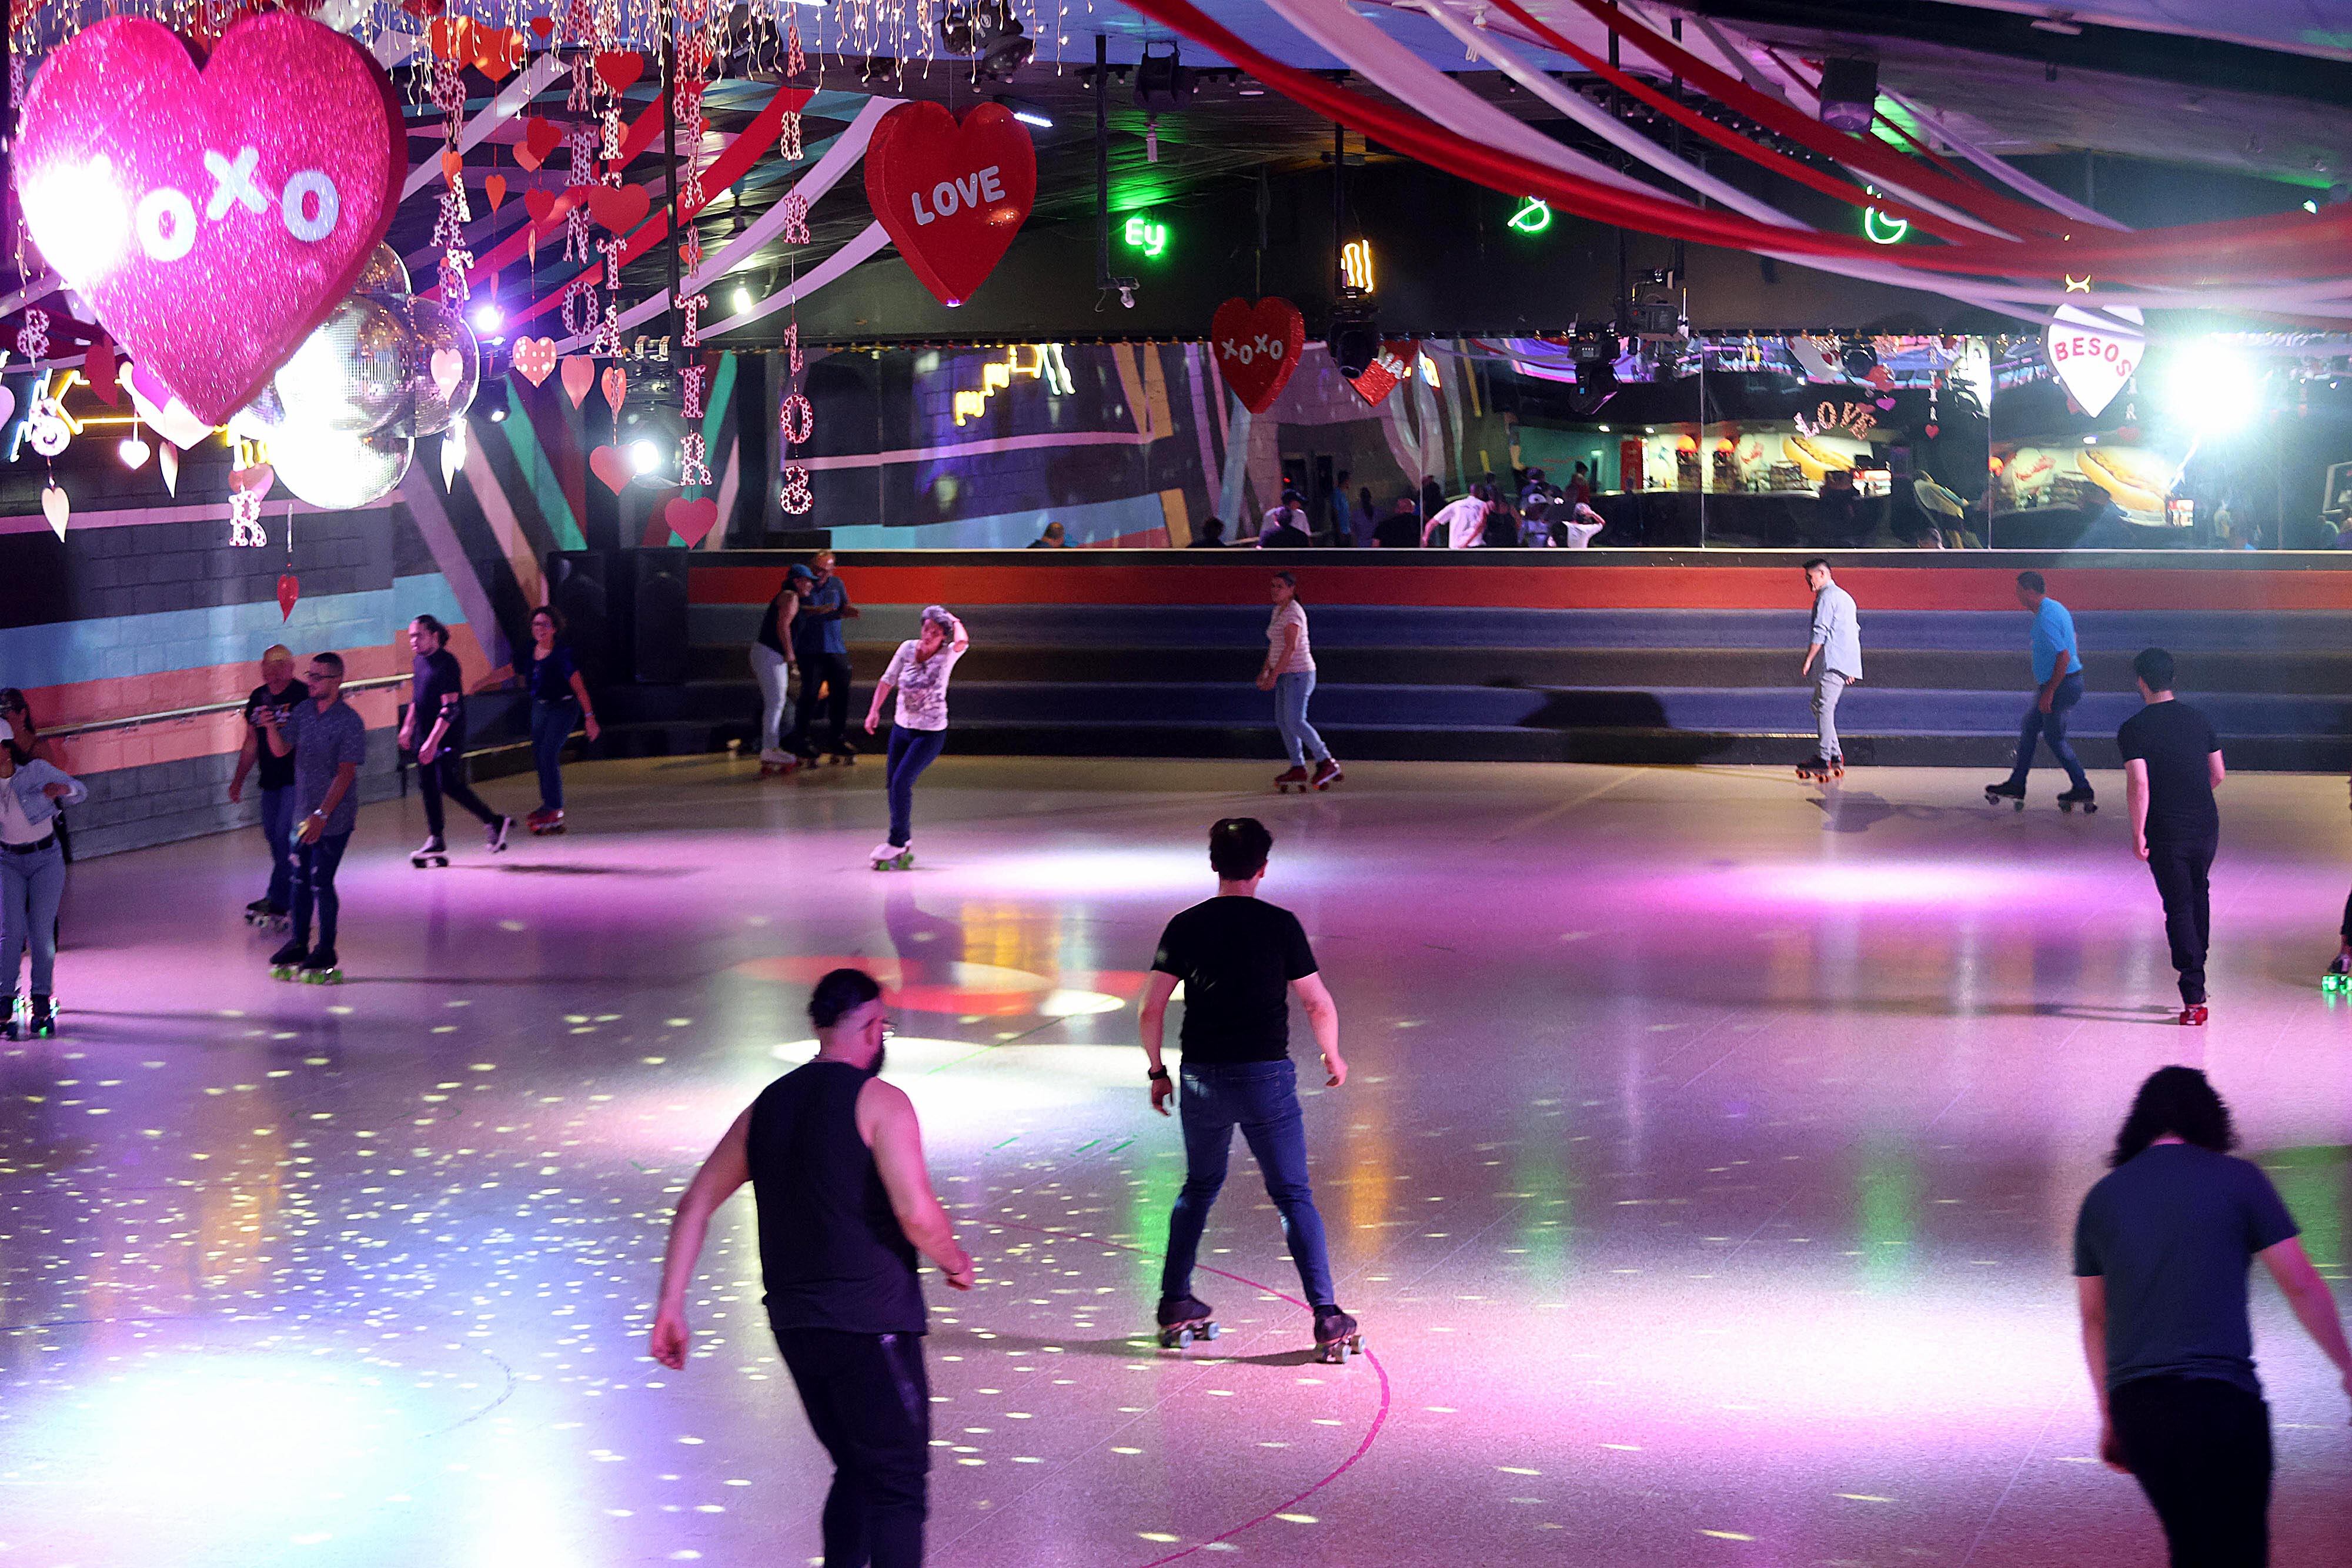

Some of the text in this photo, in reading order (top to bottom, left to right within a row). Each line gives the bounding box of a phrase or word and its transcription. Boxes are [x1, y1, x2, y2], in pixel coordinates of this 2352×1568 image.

[59, 146, 339, 262] OXO
[911, 165, 1006, 226] LOVE
[1125, 218, 1165, 256] Ey
[2054, 336, 2132, 377] BESOS
[1793, 401, 1879, 440] LOVE
